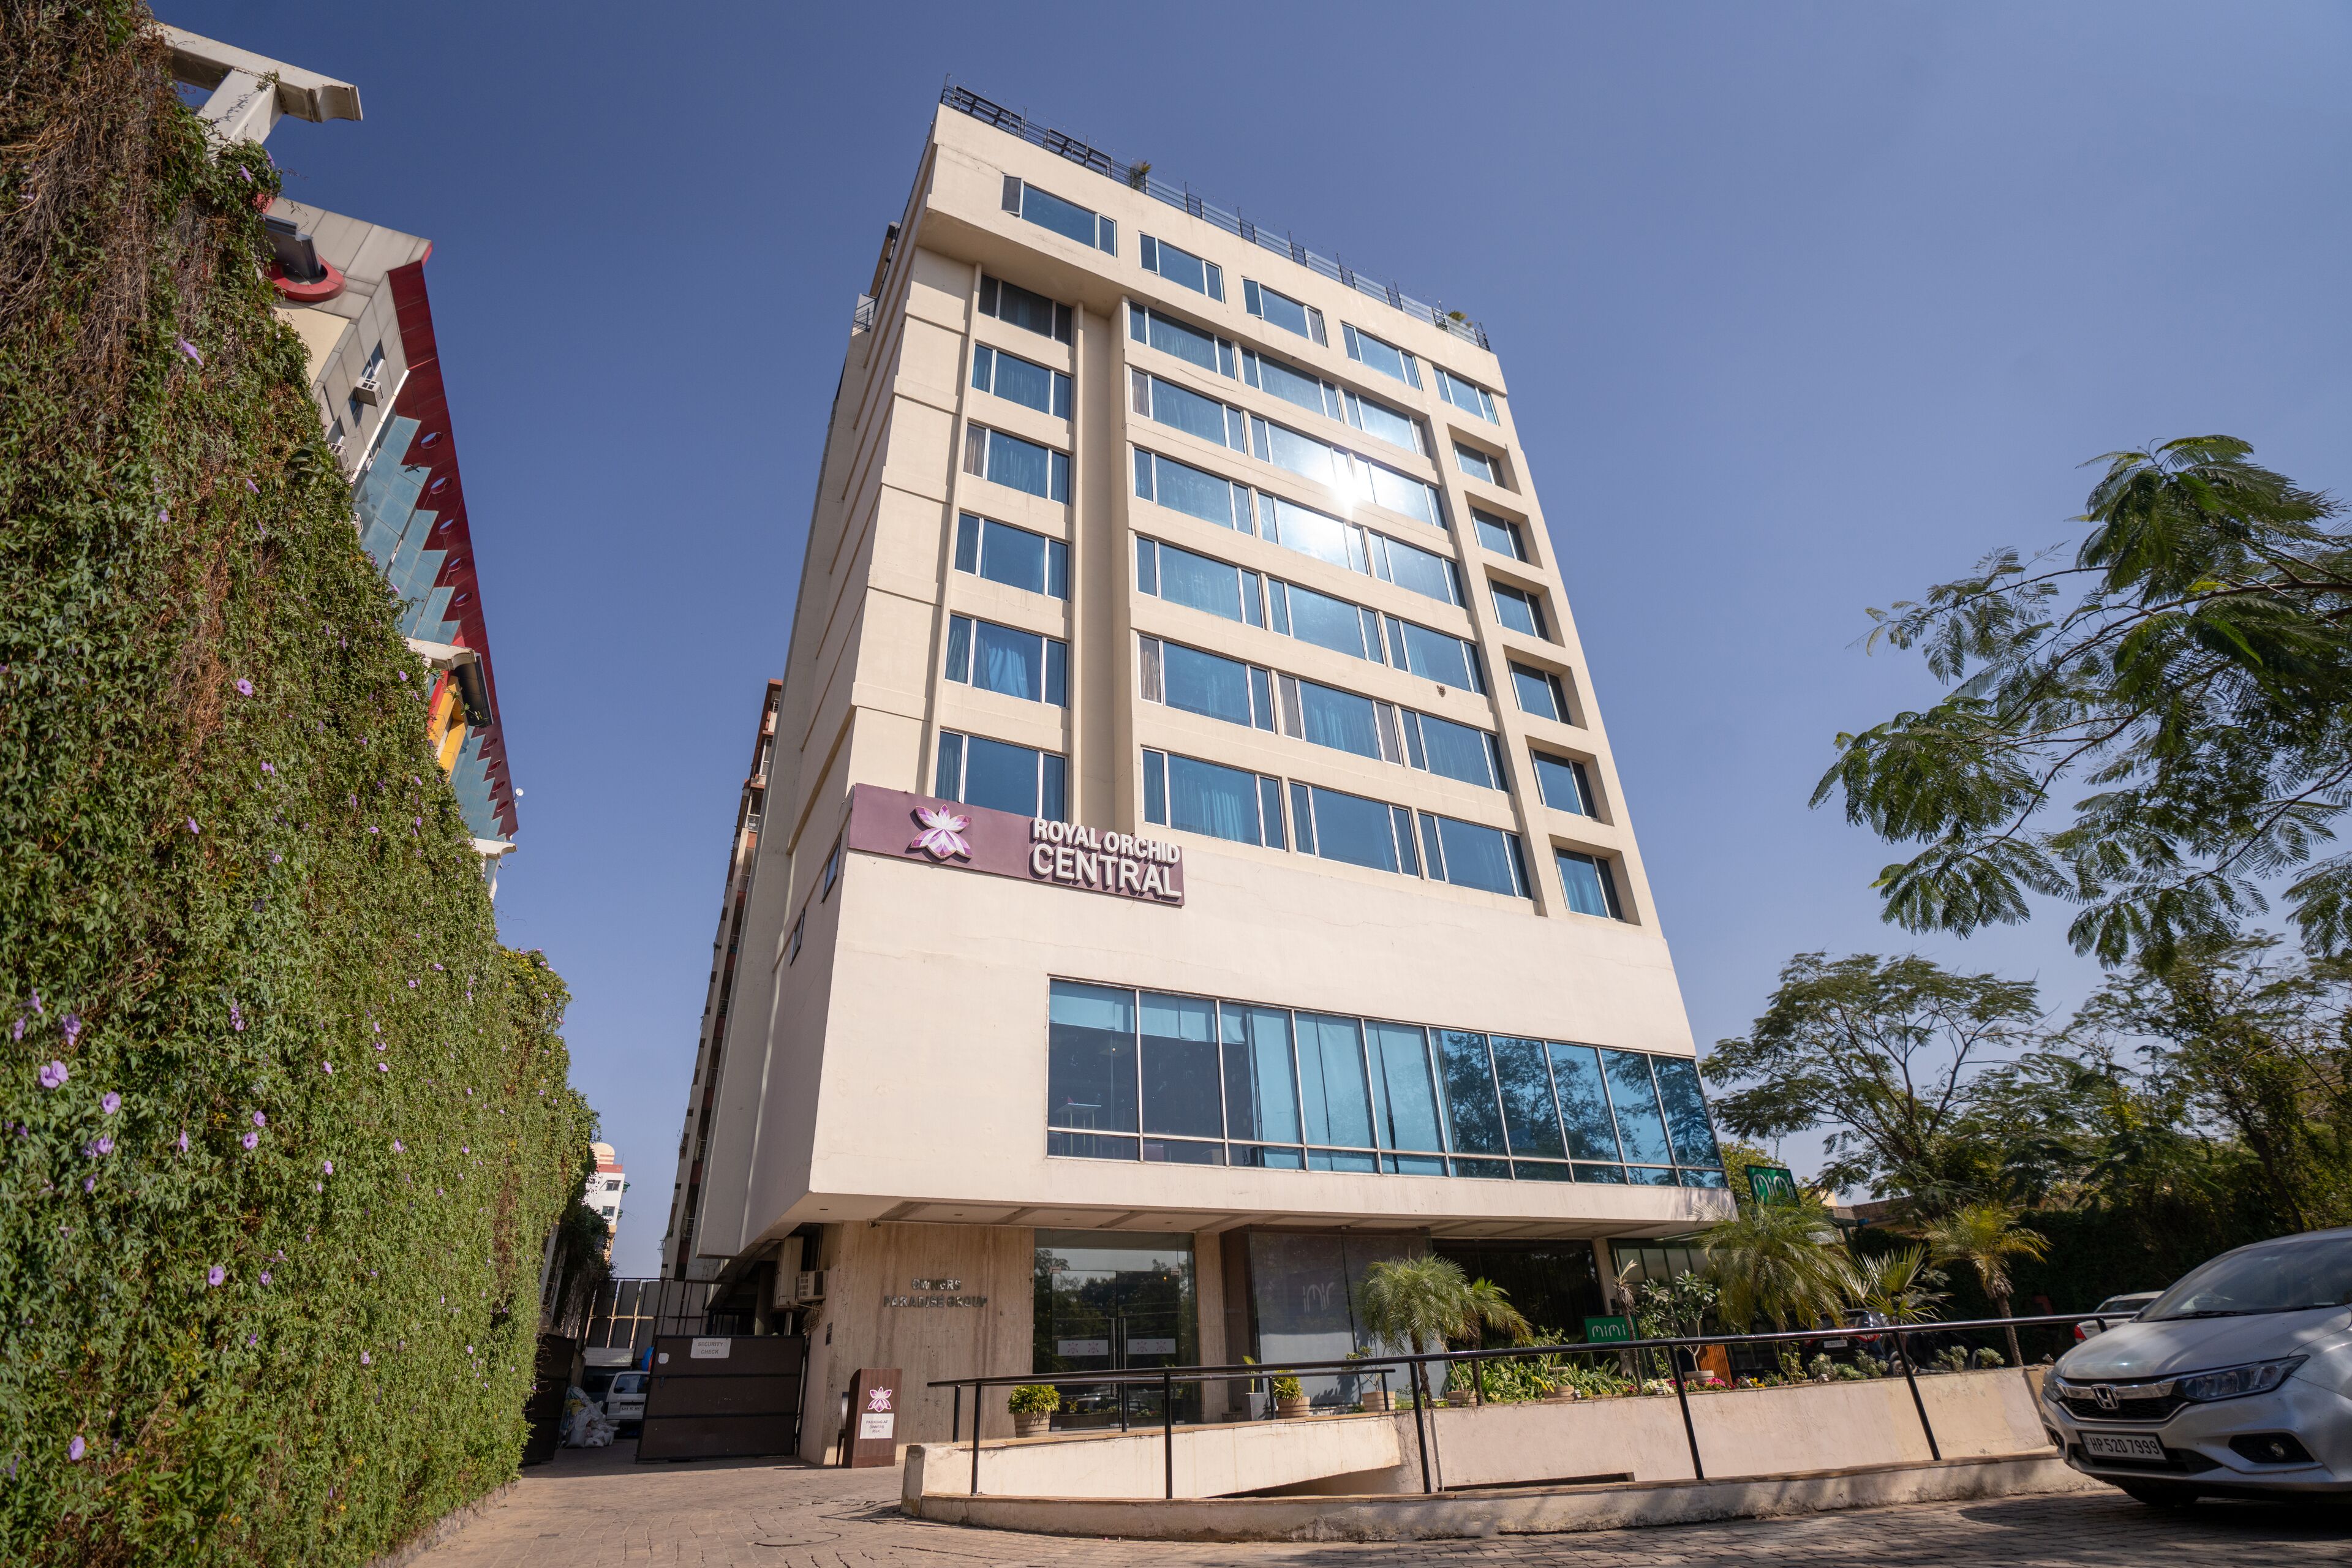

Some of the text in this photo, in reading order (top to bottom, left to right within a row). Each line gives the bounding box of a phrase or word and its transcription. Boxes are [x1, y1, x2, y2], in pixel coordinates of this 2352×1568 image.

[1033, 817, 1180, 864] ROYAL ORCHID
[1033, 843, 1182, 898] CENTRAL
[911, 1278, 961, 1291] OWNERS
[883, 1295, 988, 1308] PARADISE GROUP
[2089, 1437, 2103, 1452] HP
[2127, 1439, 2160, 1455] 7999
